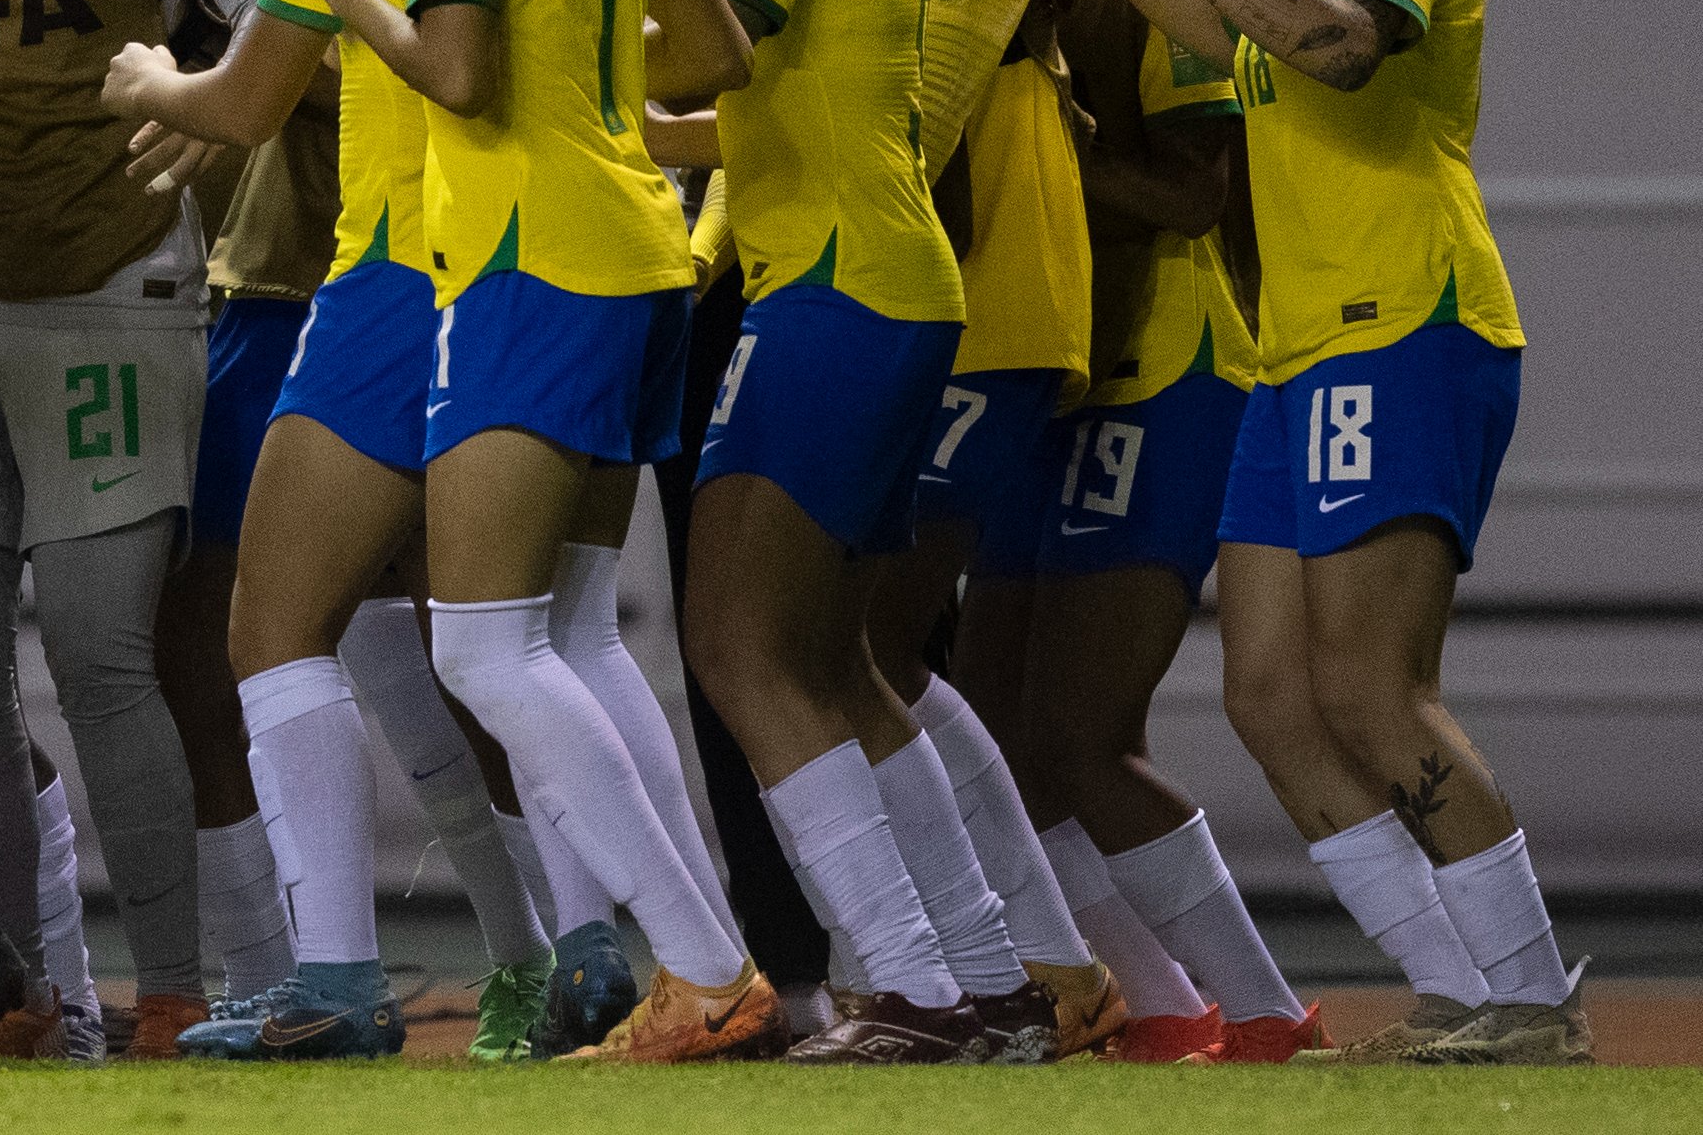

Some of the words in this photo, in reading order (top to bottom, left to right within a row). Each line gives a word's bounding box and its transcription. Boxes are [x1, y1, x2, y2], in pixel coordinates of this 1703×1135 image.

[65, 363, 140, 461] 21
[1308, 384, 1372, 484] 18
[1061, 419, 1145, 518] 19
